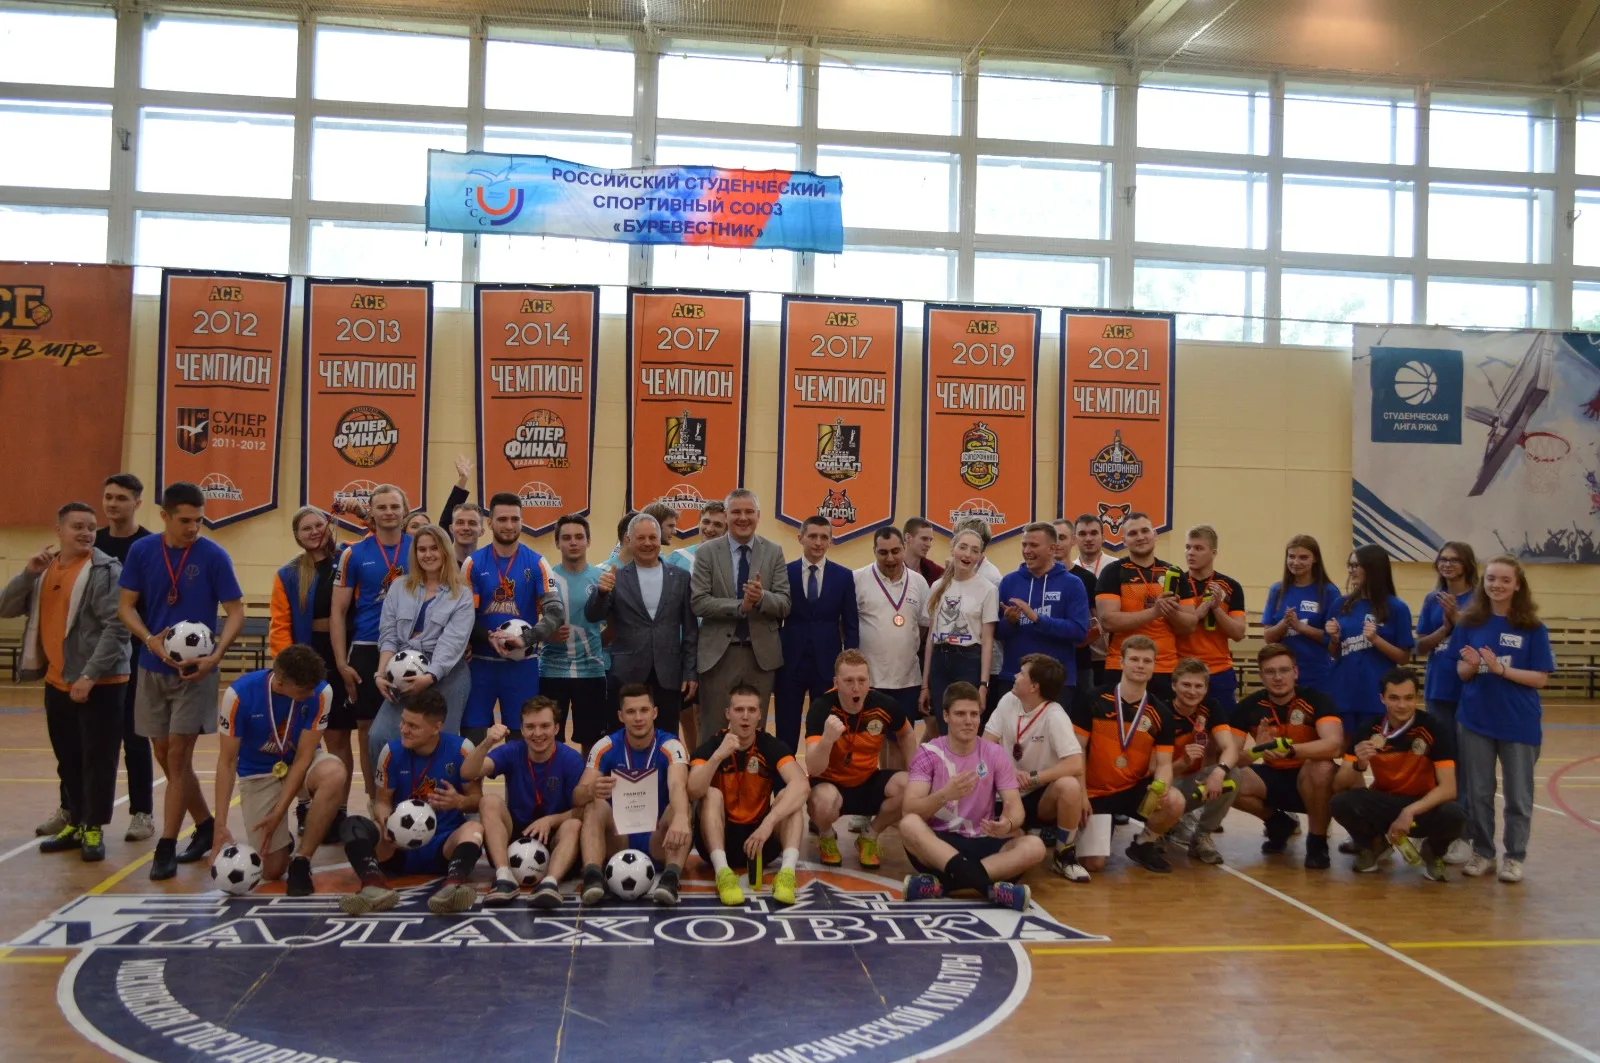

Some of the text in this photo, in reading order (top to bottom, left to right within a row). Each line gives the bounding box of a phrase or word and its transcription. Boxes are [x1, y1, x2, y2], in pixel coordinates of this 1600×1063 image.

[552, 167, 826, 198] РОССИЙСКИЙ СТУДЕНЧЕСКИЙ
[593, 195, 783, 216] СПОРТИВНЫЙ СОЮЗ
[613, 219, 764, 238] «БУРЕВЕСТНИК»
[209, 286, 242, 301] АСБ
[351, 294, 387, 310] АСБ
[0, 288, 43, 327] СБ
[520, 299, 554, 314] АСБ
[672, 303, 705, 318] АСБ
[192, 311, 259, 337] 2012
[825, 312, 859, 327] АСБ
[966, 320, 999, 335] АСБ
[336, 318, 401, 343] 2013
[504, 322, 571, 346] 2014
[657, 327, 720, 351] 2017
[1102, 324, 1134, 339] АСБ
[38, 342, 103, 367] игре
[811, 335, 873, 359] 2017
[952, 342, 1015, 367] 2019
[175, 353, 272, 385] ЧЕМПИОН
[1088, 347, 1149, 371] 2021
[318, 360, 416, 390] ЧЕМПИОН
[490, 364, 583, 393] ЧЕМПИОН
[641, 368, 733, 398] ЧЕМПИОН
[794, 374, 886, 405] ЧЕМПИОН
[936, 382, 1026, 411] ЧЕМПИОН
[1073, 386, 1160, 415] ЧЕМПИОН
[212, 411, 267, 426] СУПЕР
[341, 420, 387, 434] СУПЕР
[1383, 412, 1449, 421] СТУДЕНЧЕСКАЯ
[212, 425, 266, 438] ФИНАЛ
[516, 425, 565, 441] СУПЕР
[1393, 423, 1439, 432] ЛИГА РЖД
[212, 438, 267, 451] 2011-2012
[333, 429, 398, 449] ФИНАЛ
[505, 440, 567, 458] ФИНАЛ
[1093, 463, 1139, 473] СУПЕРФИНАЛ
[116, 958, 200, 1030] МОСКОВСКАЯ
[912, 953, 982, 1011] КУЛЬТУРЫ
